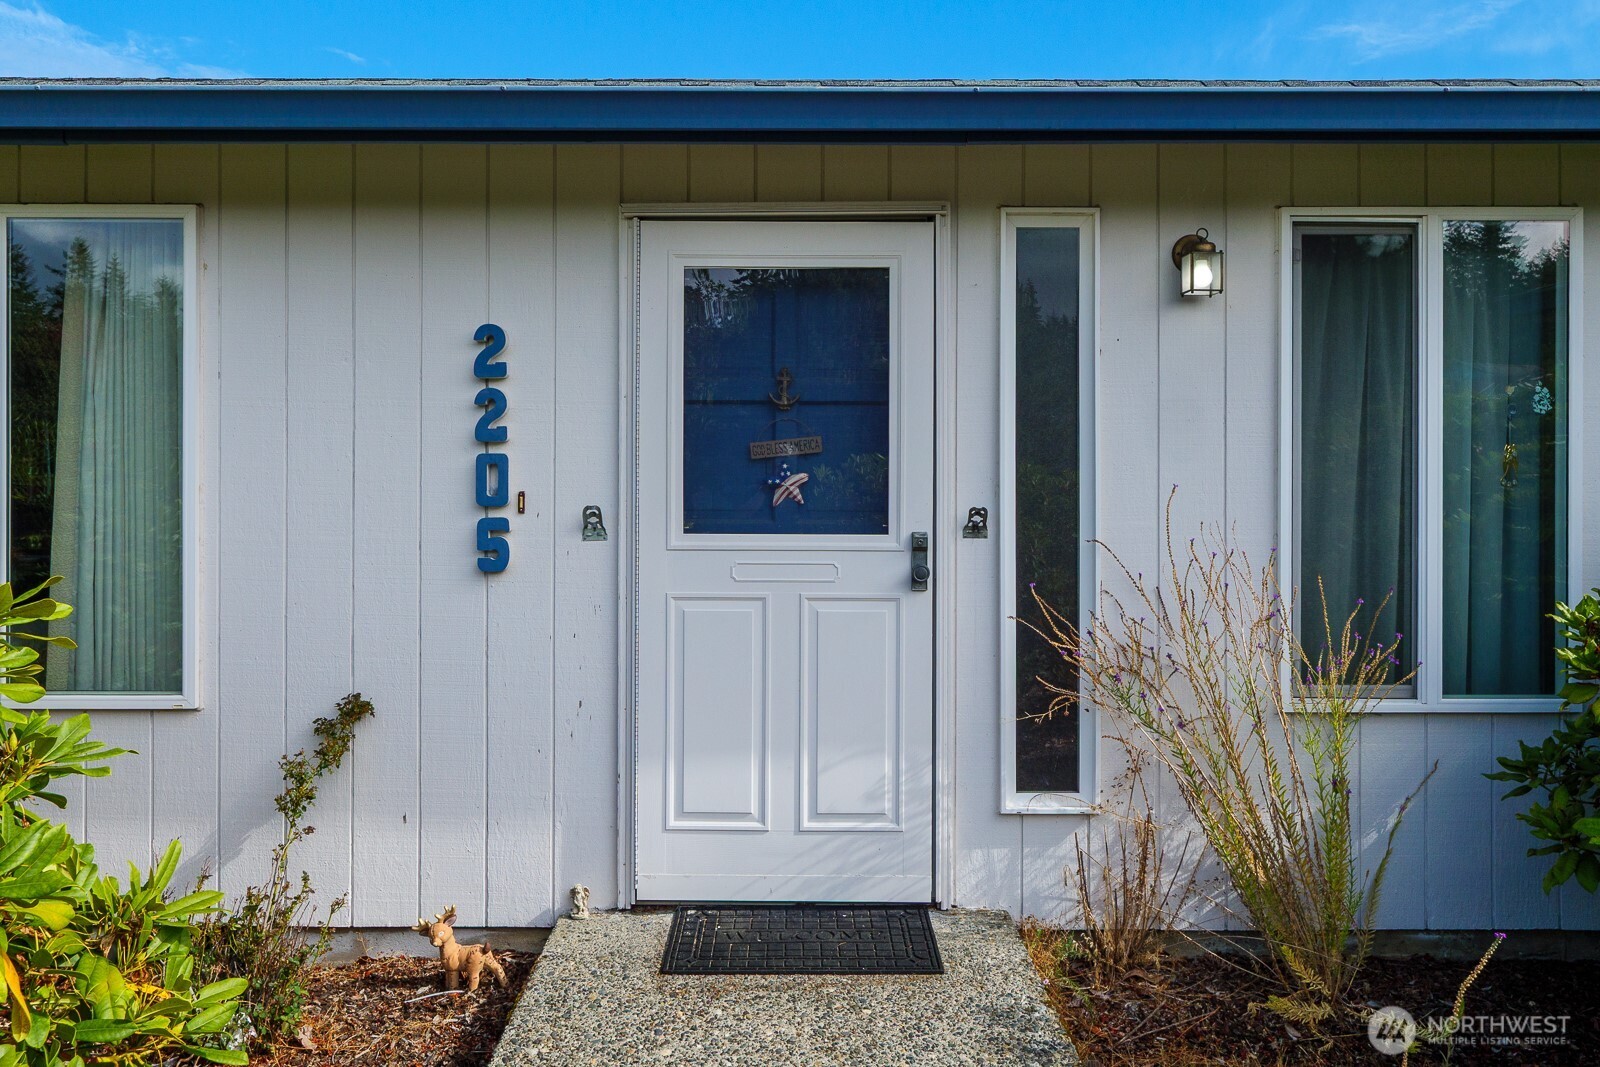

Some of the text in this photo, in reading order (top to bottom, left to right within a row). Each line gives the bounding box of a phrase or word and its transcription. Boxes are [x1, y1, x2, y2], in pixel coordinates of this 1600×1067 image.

[473, 323, 510, 573] 2205
[752, 438, 820, 457] GOD BLESS AMERICA
[724, 930, 887, 942] WELCOME
